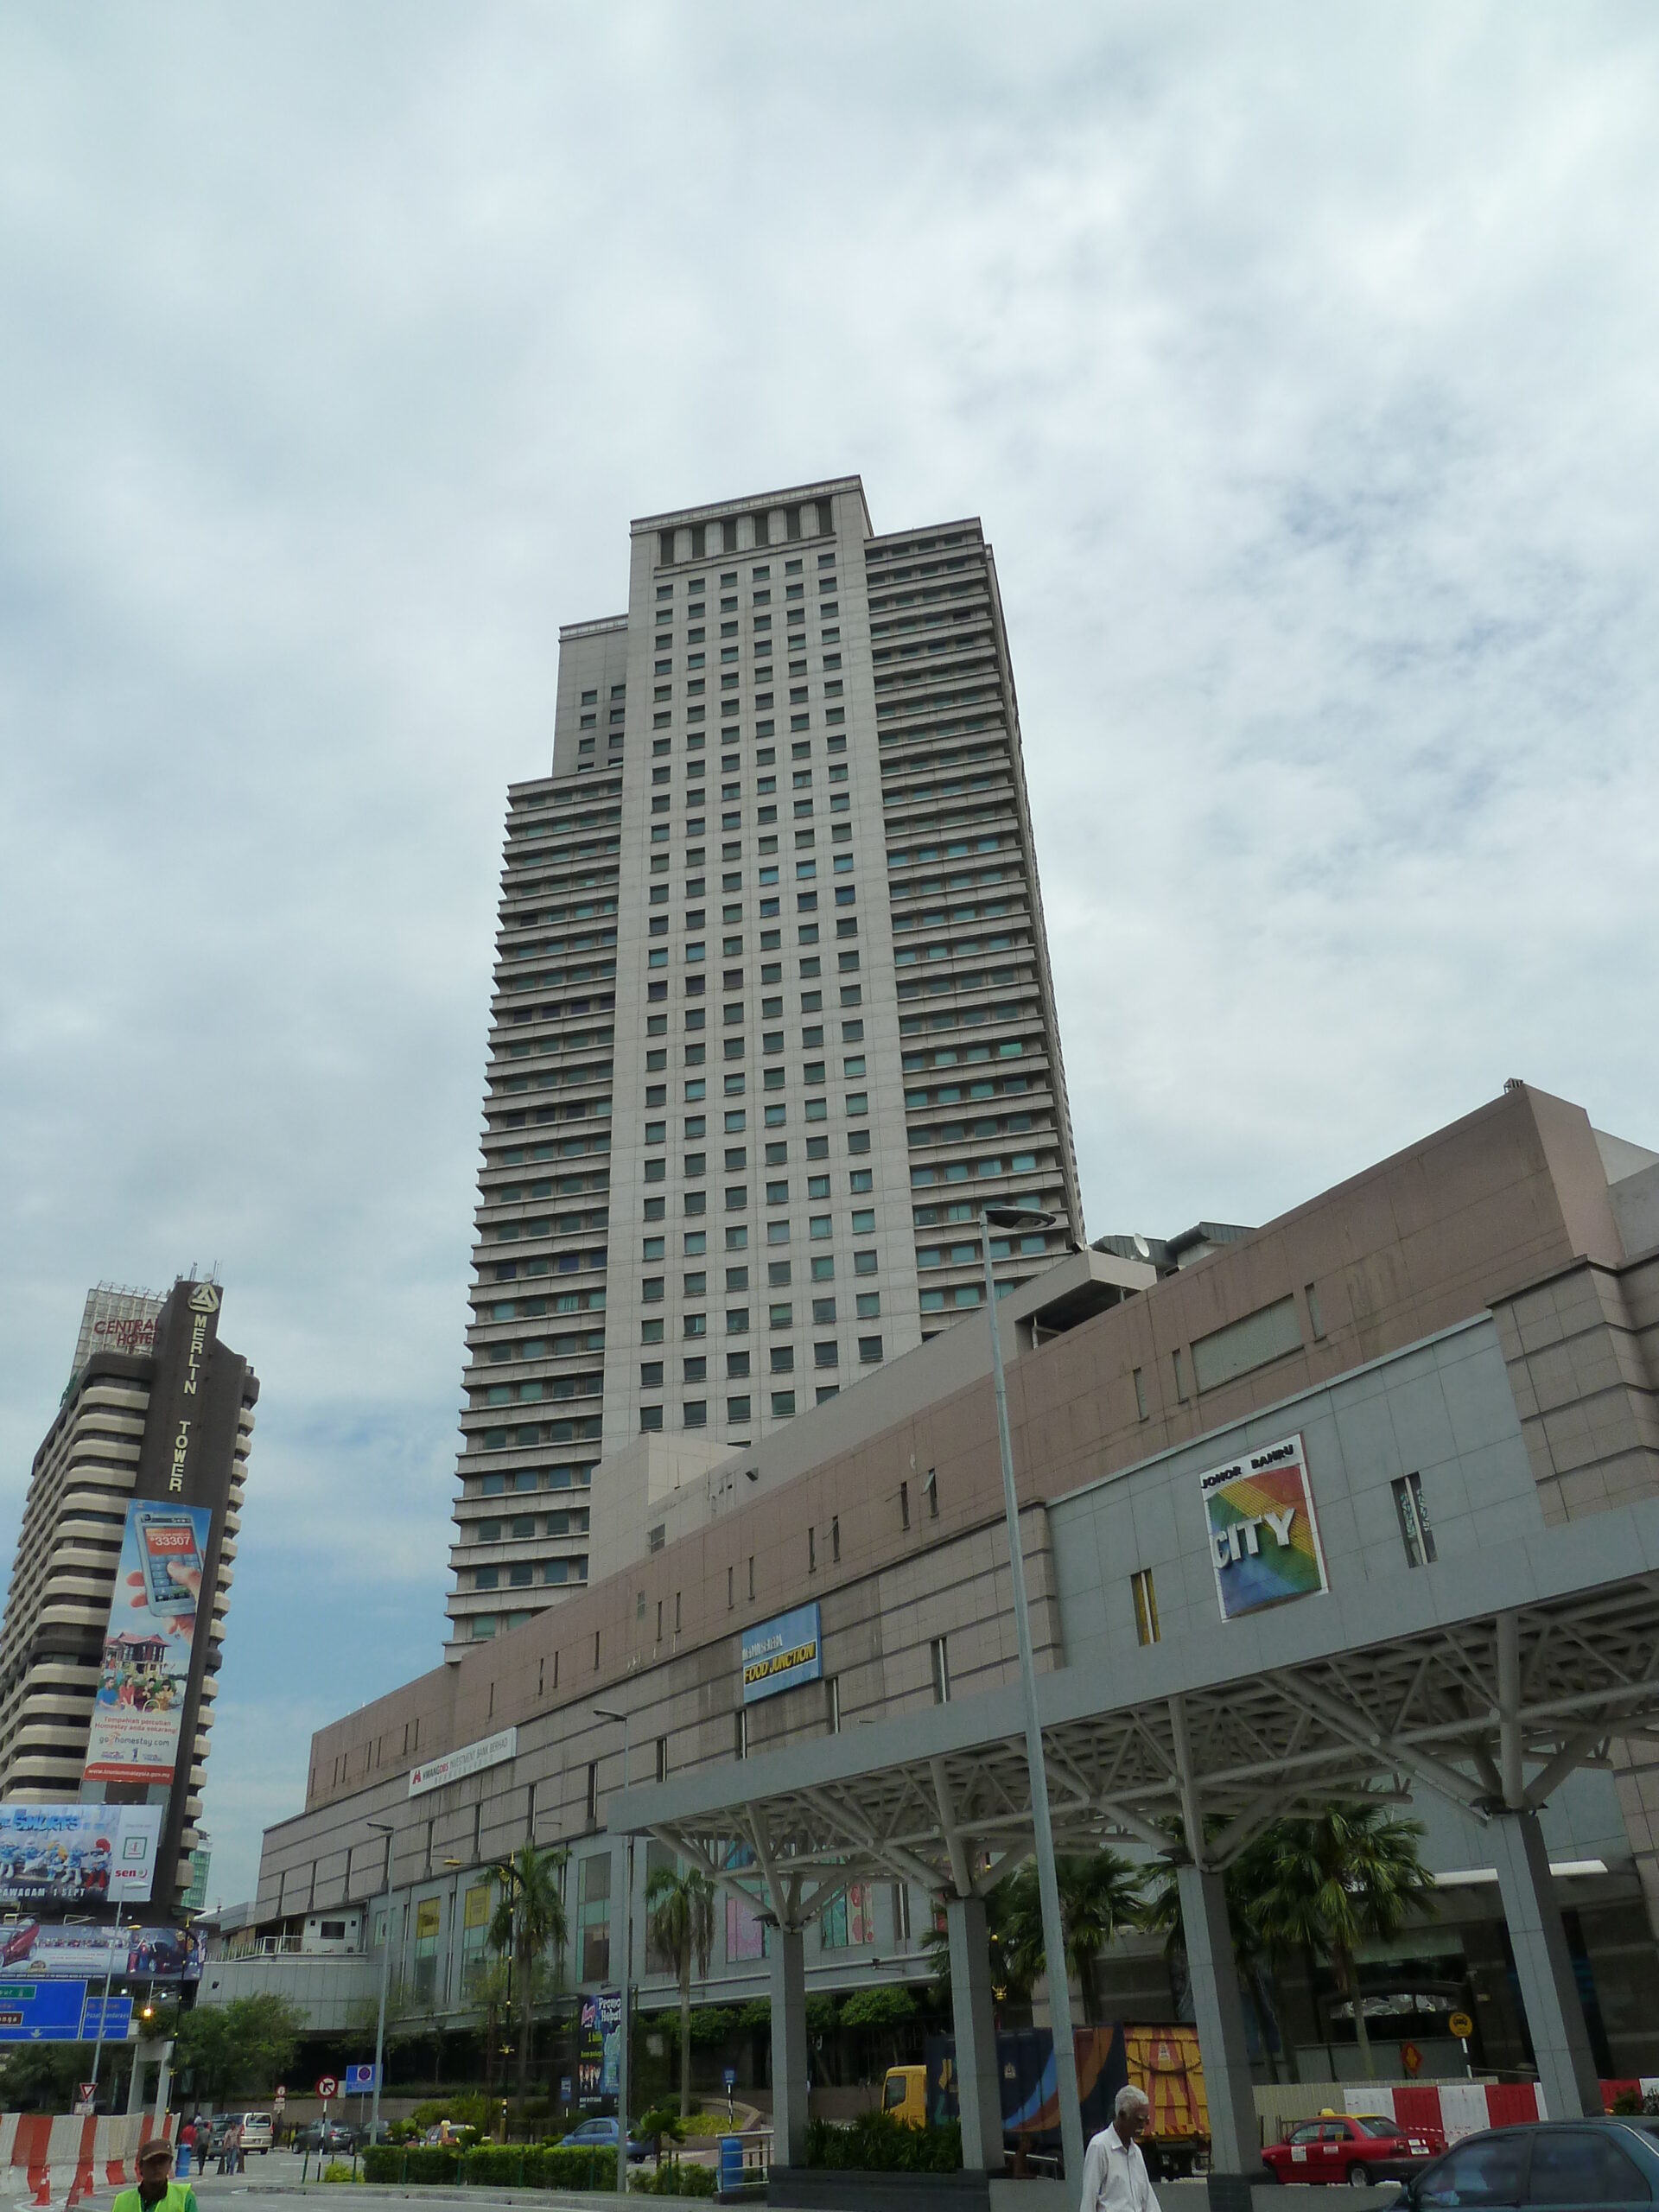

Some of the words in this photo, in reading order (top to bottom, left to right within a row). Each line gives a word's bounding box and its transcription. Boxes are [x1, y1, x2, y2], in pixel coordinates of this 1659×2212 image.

[183, 1313, 207, 1395] MERLIN
[168, 1421, 191, 1493] TOWER
[1201, 1465, 1242, 1489] JOHOR
[1250, 1444, 1294, 1469] BAHRU
[1211, 1507, 1295, 1569] CITY
[745, 1661, 769, 1681] FOOD
[769, 1643, 815, 1674] JUNCTION
